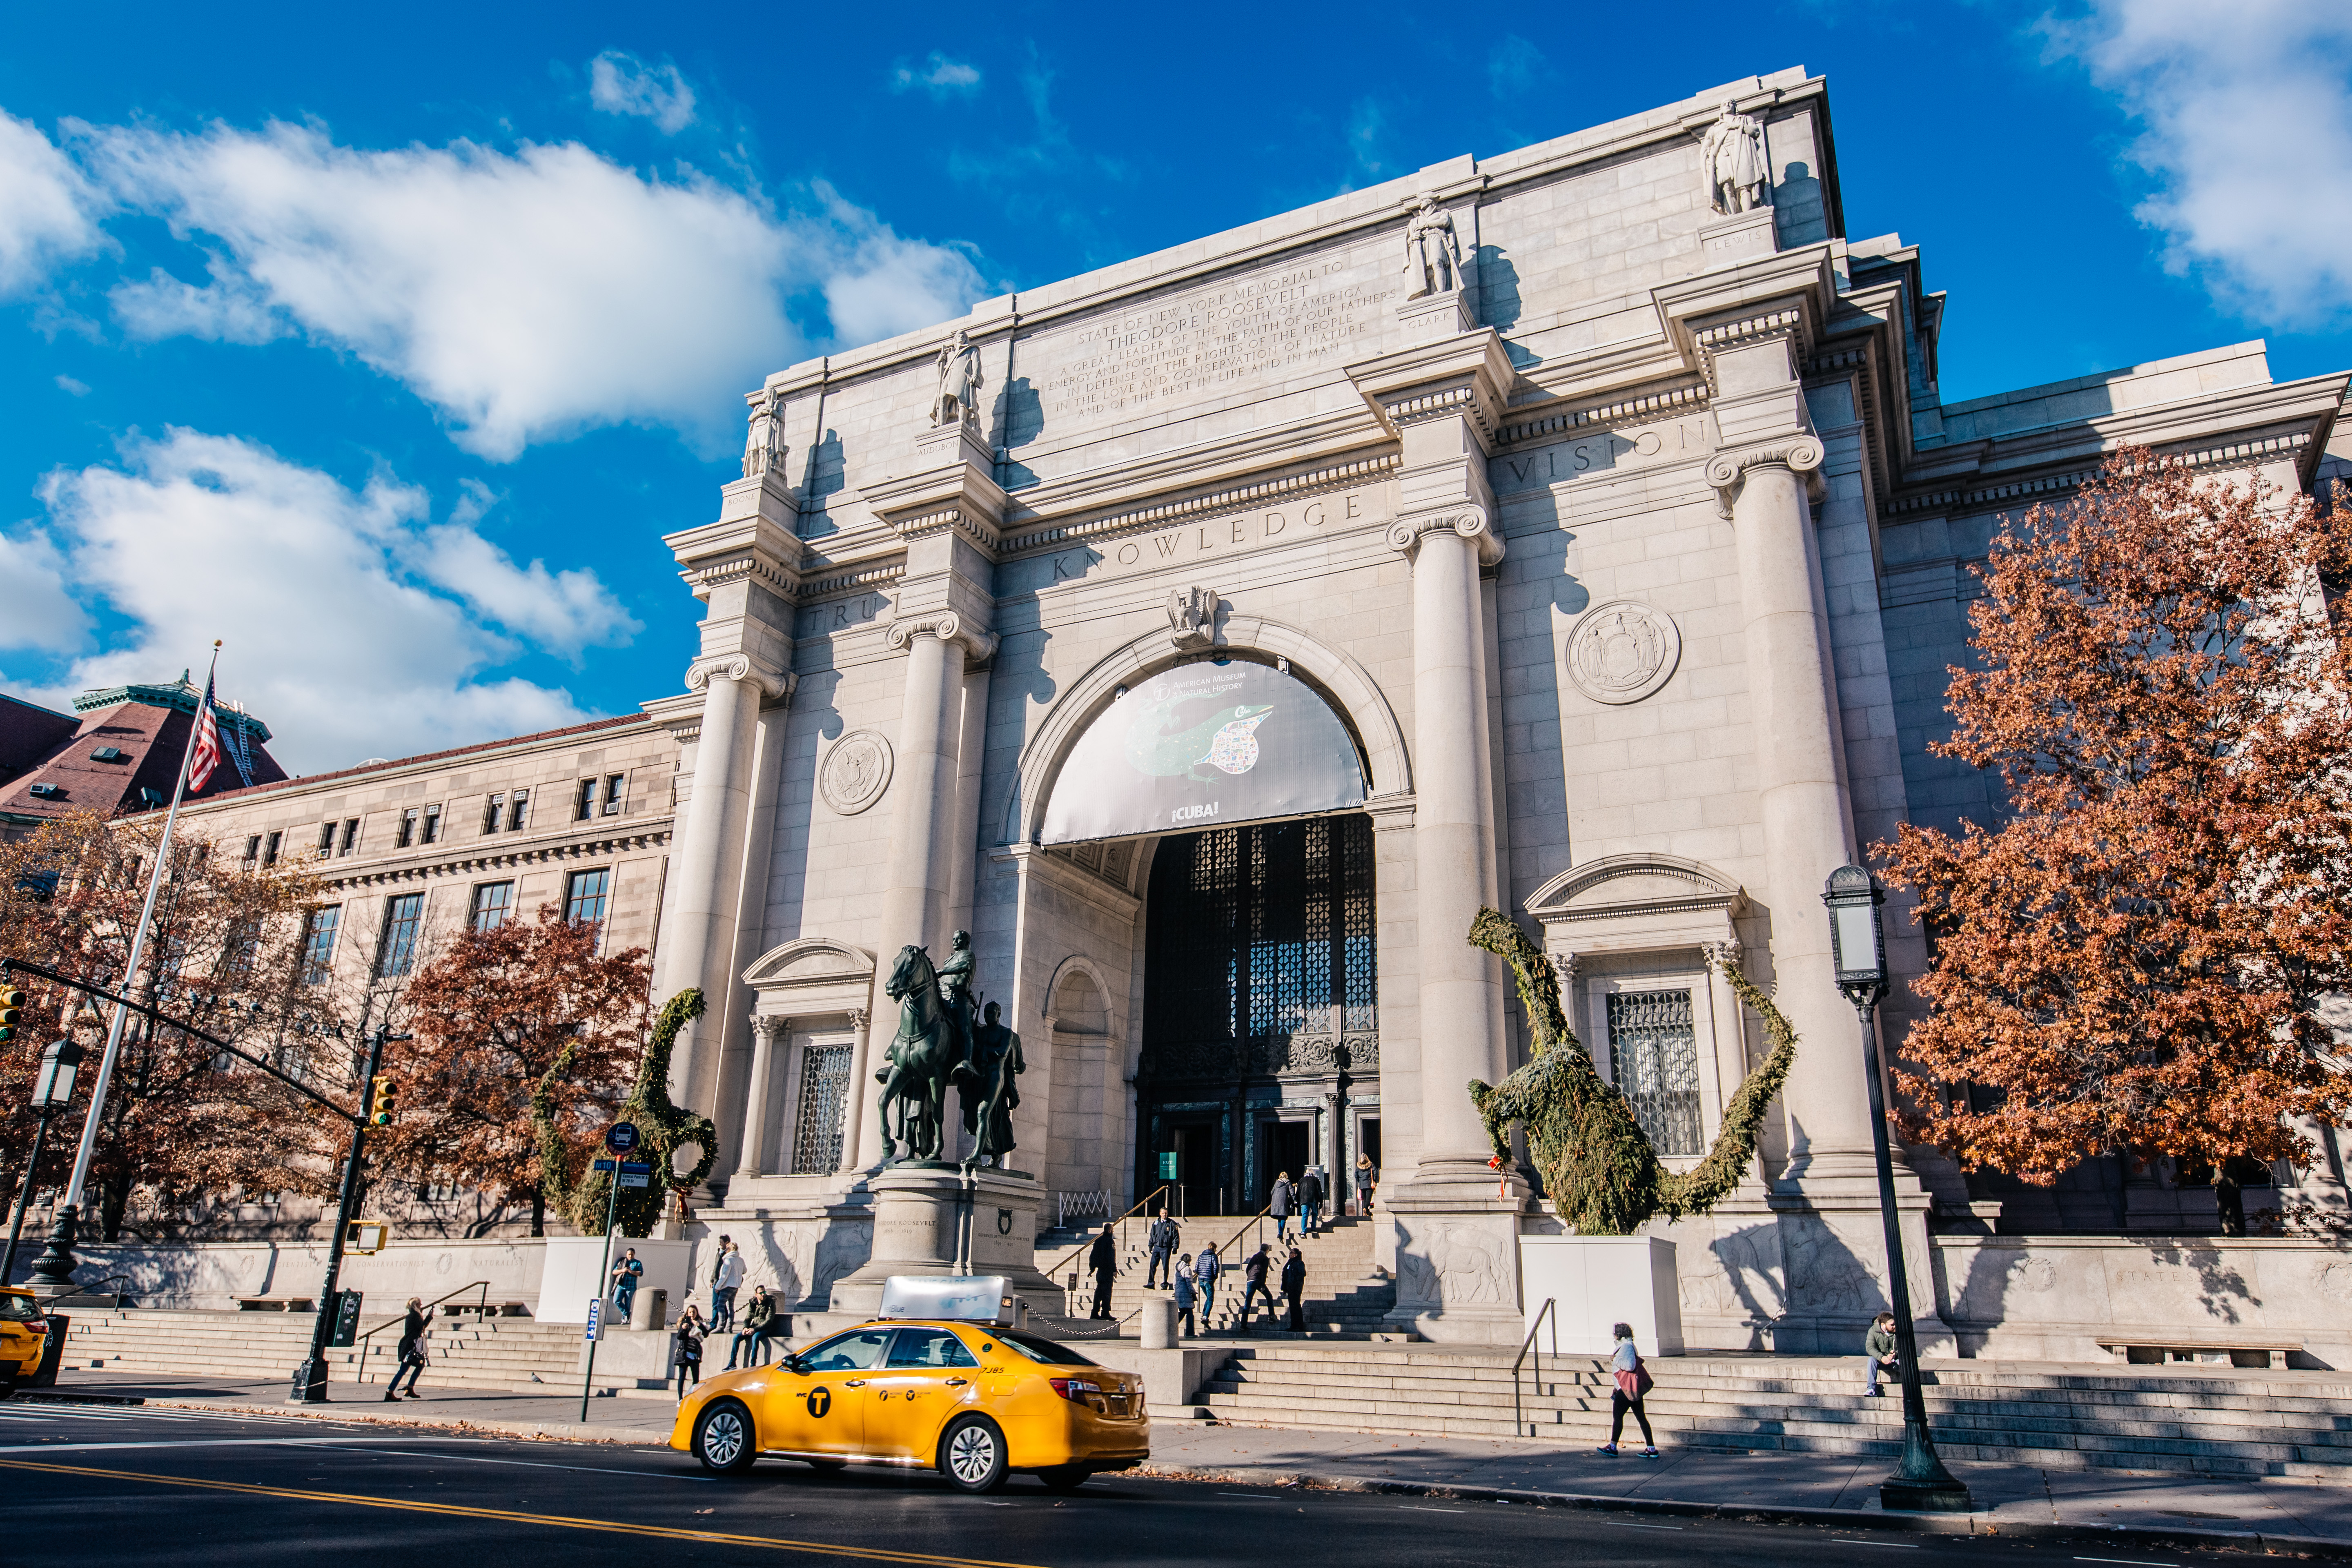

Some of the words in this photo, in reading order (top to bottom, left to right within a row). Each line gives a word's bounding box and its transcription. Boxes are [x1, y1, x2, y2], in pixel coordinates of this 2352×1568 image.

[1715, 231, 1761, 250] LEWIS
[1078, 325, 1118, 344] STATE
[1125, 318, 1143, 330] OF
[1150, 307, 1180, 324] NEW
[1188, 294, 1226, 312] YORK
[1235, 270, 1316, 301] MEMORIAL
[1322, 261, 1343, 275] TO
[1107, 315, 1199, 350] THEODORE
[1207, 285, 1309, 323] ROOSEVELT
[1408, 312, 1451, 328] CLARK
[1033, 384, 1043, 395] IN
[1049, 372, 1091, 391] ENERGY
[1096, 365, 1120, 378] AND
[1126, 345, 1191, 370] FORTITUDE
[1198, 340, 1209, 350] IN
[1214, 332, 1238, 345] THE
[1243, 321, 1278, 338] FAITH
[1285, 315, 1302, 326] OF
[1307, 306, 1336, 320] OUR
[1341, 289, 1396, 311] FATHERS
[1061, 368, 1067, 376] A
[1074, 354, 1112, 372] GREAT
[1119, 341, 1165, 360] LEADER
[1172, 334, 1187, 345] OF
[1194, 325, 1218, 339] THE
[1225, 311, 1270, 330] YOUTH
[1278, 304, 1295, 316] OF
[1301, 287, 1362, 310] AMERICA
[1068, 386, 1079, 397] IN
[1087, 371, 1137, 392] DEFENSE
[1143, 365, 1159, 376] OF
[1165, 357, 1188, 371] THE
[1195, 343, 1242, 363] RIGHTS
[1249, 337, 1265, 348] OF
[1271, 329, 1296, 342] THE
[1305, 314, 1353, 334] PEOPLE
[1056, 401, 1068, 411] IN
[1074, 394, 1096, 407] THE
[1104, 383, 1134, 399] LOVE
[1141, 376, 1167, 390] AND
[1174, 346, 1276, 380] CONSERVATION
[1285, 339, 1302, 351] OF
[1310, 323, 1365, 345] NATURE
[1078, 404, 1104, 418] AND
[1110, 398, 1126, 408] OF
[1132, 390, 1156, 404] THE
[1163, 381, 1192, 396] BEST
[1198, 376, 1210, 387] IN
[1219, 367, 1245, 382] LIFE
[1252, 359, 1280, 373] AND
[1287, 352, 1300, 363] IN
[1309, 343, 1339, 358] MAN
[918, 440, 959, 456] AUDUBON
[1507, 420, 1708, 484] VISION
[728, 493, 755, 506] BOONE
[1053, 494, 1362, 581] KNOWLEDGE
[1604, 673, 1643, 685] EXCELSIOR
[1235, 705, 1251, 718] Cuba
[1172, 801, 1218, 822] ¡CUBA!
[614, 1147, 635, 1155] STANDING
[2117, 1271, 2245, 1283] STATESMAN
[813, 1392, 826, 1414] T
